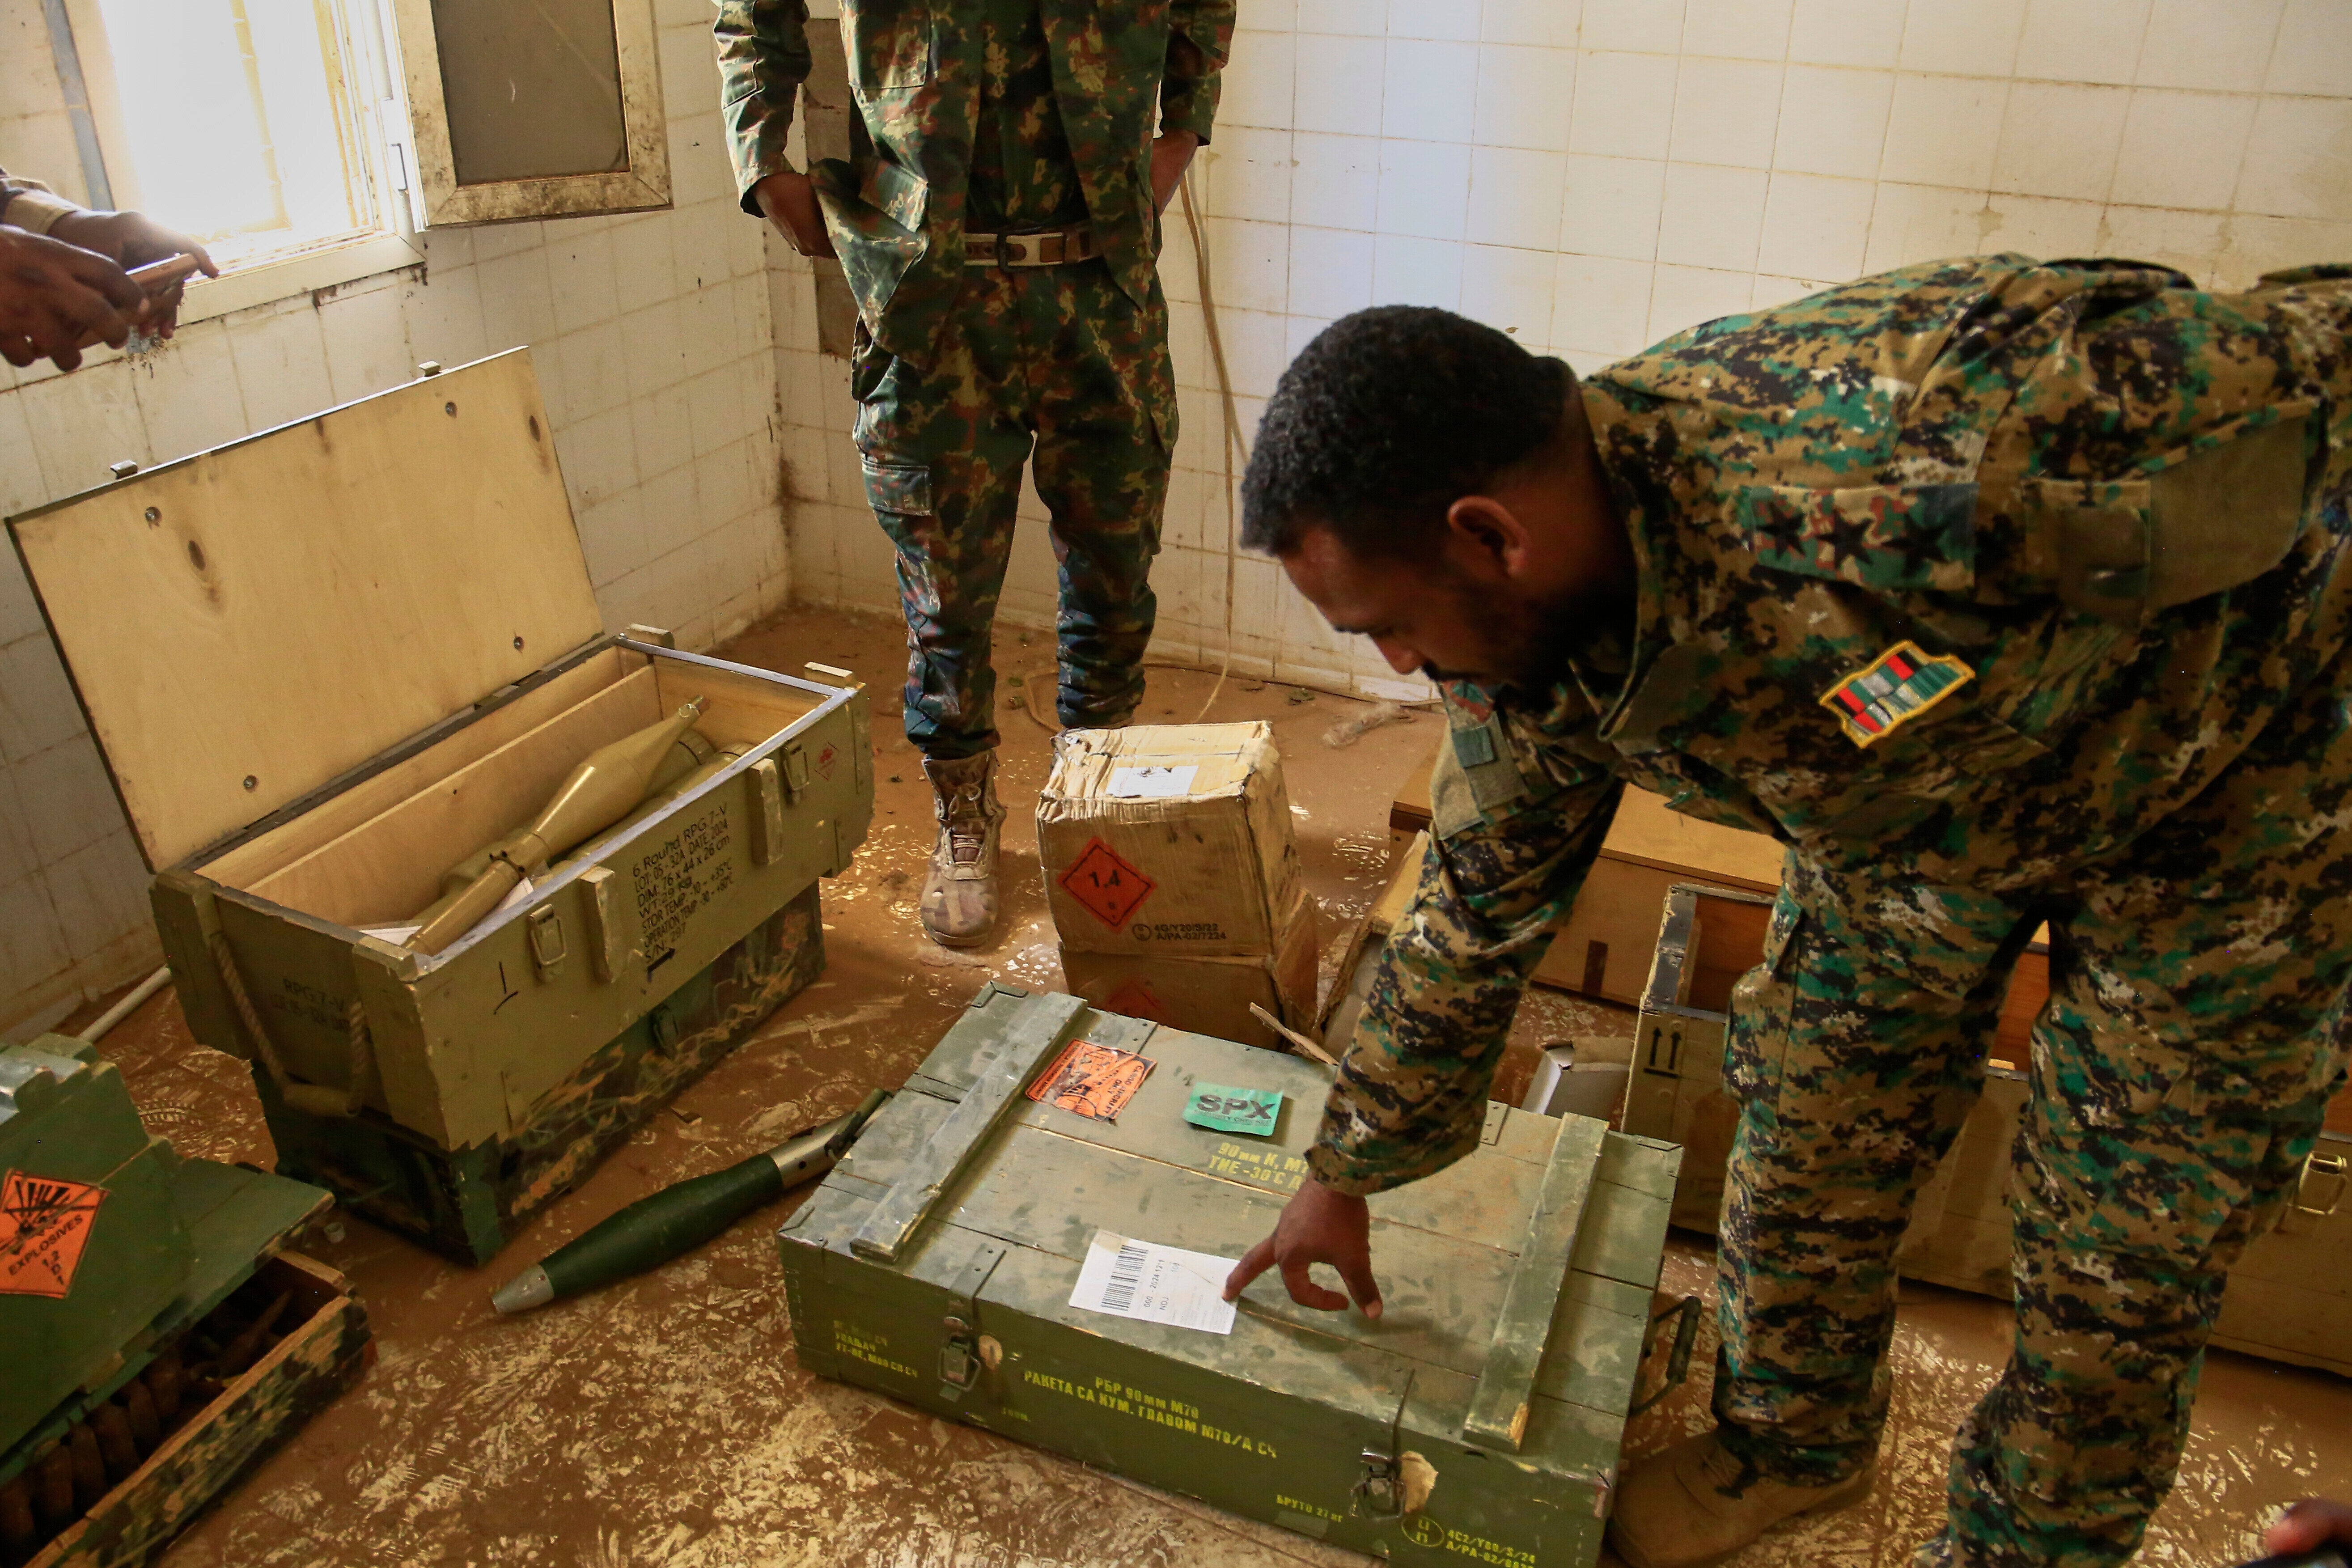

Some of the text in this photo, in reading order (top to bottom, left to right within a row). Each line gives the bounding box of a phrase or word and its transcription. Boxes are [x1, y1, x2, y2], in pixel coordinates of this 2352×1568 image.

[633, 864, 640, 877] 6
[644, 835, 681, 870] Round
[683, 818, 707, 842] RPG
[703, 843, 715, 860] 26
[717, 835, 730, 851] cm
[1089, 869, 1121, 888] 1.4
[1125, 1065, 1143, 1085] CARGO
[1107, 1079, 1123, 1094] ONLY
[1103, 1085, 1126, 1114] AIRCRAFT
[1196, 1094, 1276, 1119] SPX
[8, 1214, 83, 1276] EXPLOSIVES
[1159, 1297, 1170, 1311] NDJ
[1024, 1369, 1073, 1396] РАКЕТА
[1077, 1386, 1096, 1403] СА
[1096, 1377, 1122, 1395] РБР
[1277, 1494, 1313, 1513] БРУТО
